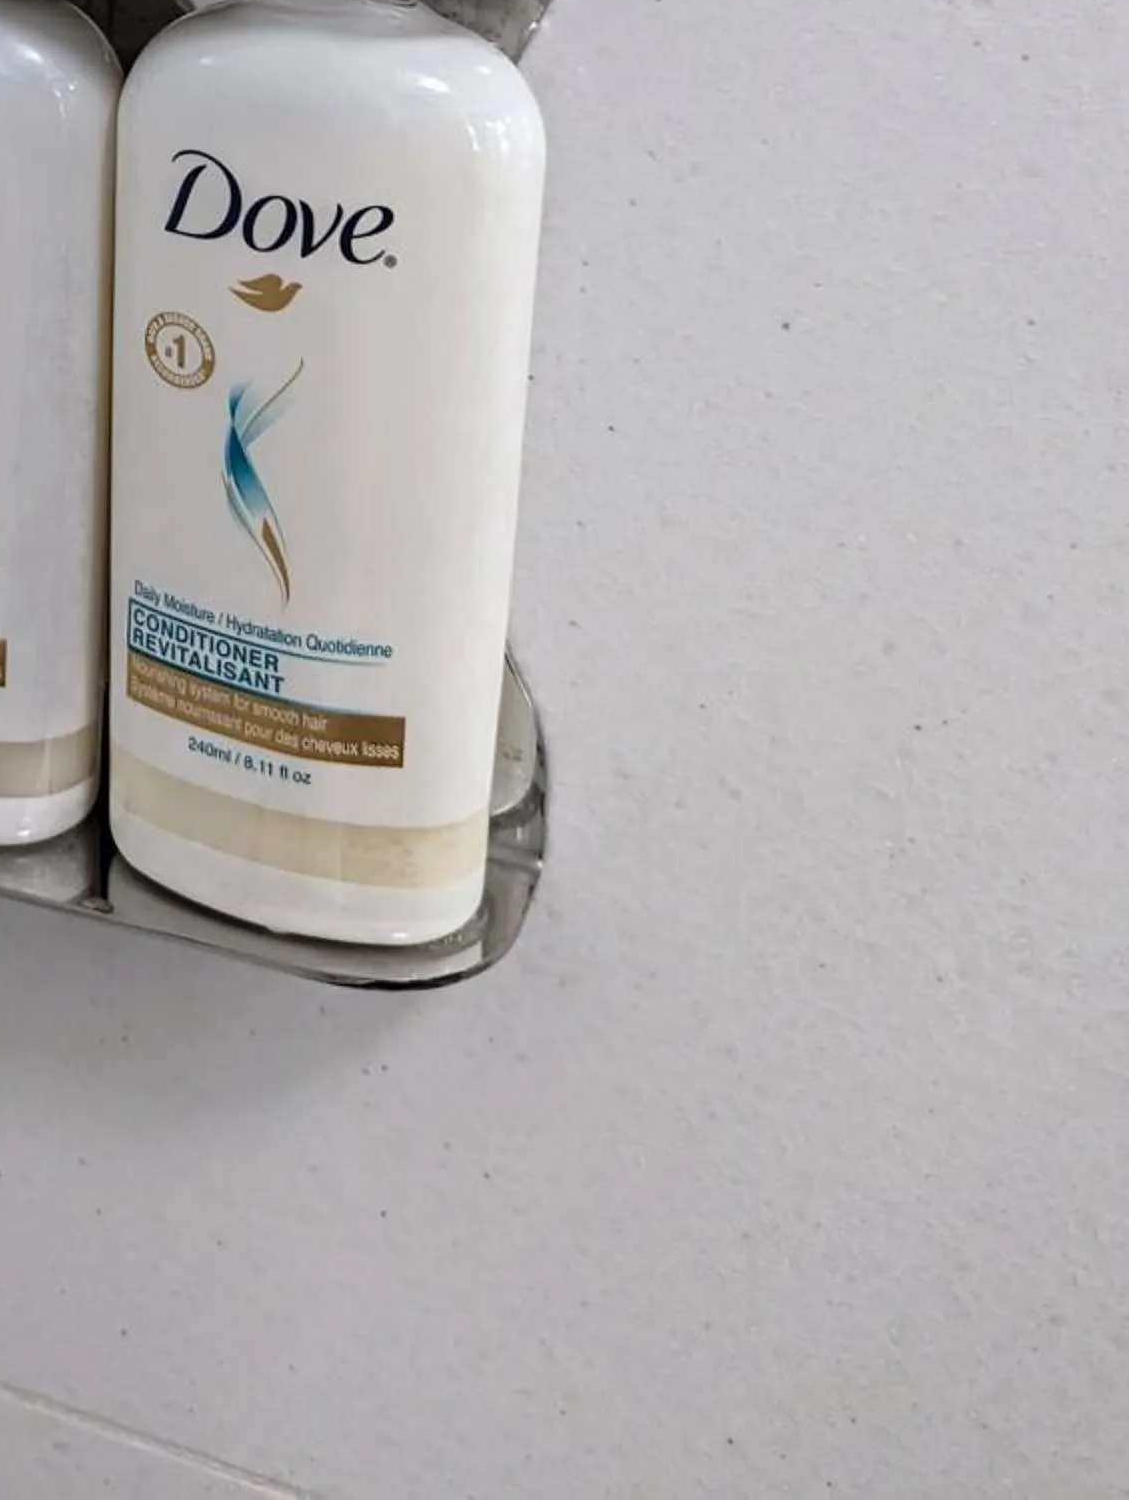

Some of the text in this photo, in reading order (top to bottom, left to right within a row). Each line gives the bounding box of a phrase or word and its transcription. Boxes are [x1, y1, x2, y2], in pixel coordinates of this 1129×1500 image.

[165, 149, 394, 266] Dove
[133, 607, 279, 672] CONDITIONER
[134, 579, 161, 607] Daily
[164, 591, 215, 623] Moisture
[226, 611, 302, 648] Hydratation
[306, 633, 393, 658] Quotidienne
[133, 626, 285, 693] REVITALISANT
[244, 720, 272, 741] pour
[275, 726, 299, 749] des
[302, 733, 359, 757] cheveux
[253, 701, 300, 726] smooth
[303, 712, 328, 732] hair
[187, 735, 232, 764] 240ml
[243, 755, 273, 777] 8.11
[279, 763, 289, 780] fl
[292, 770, 312, 785] oz
